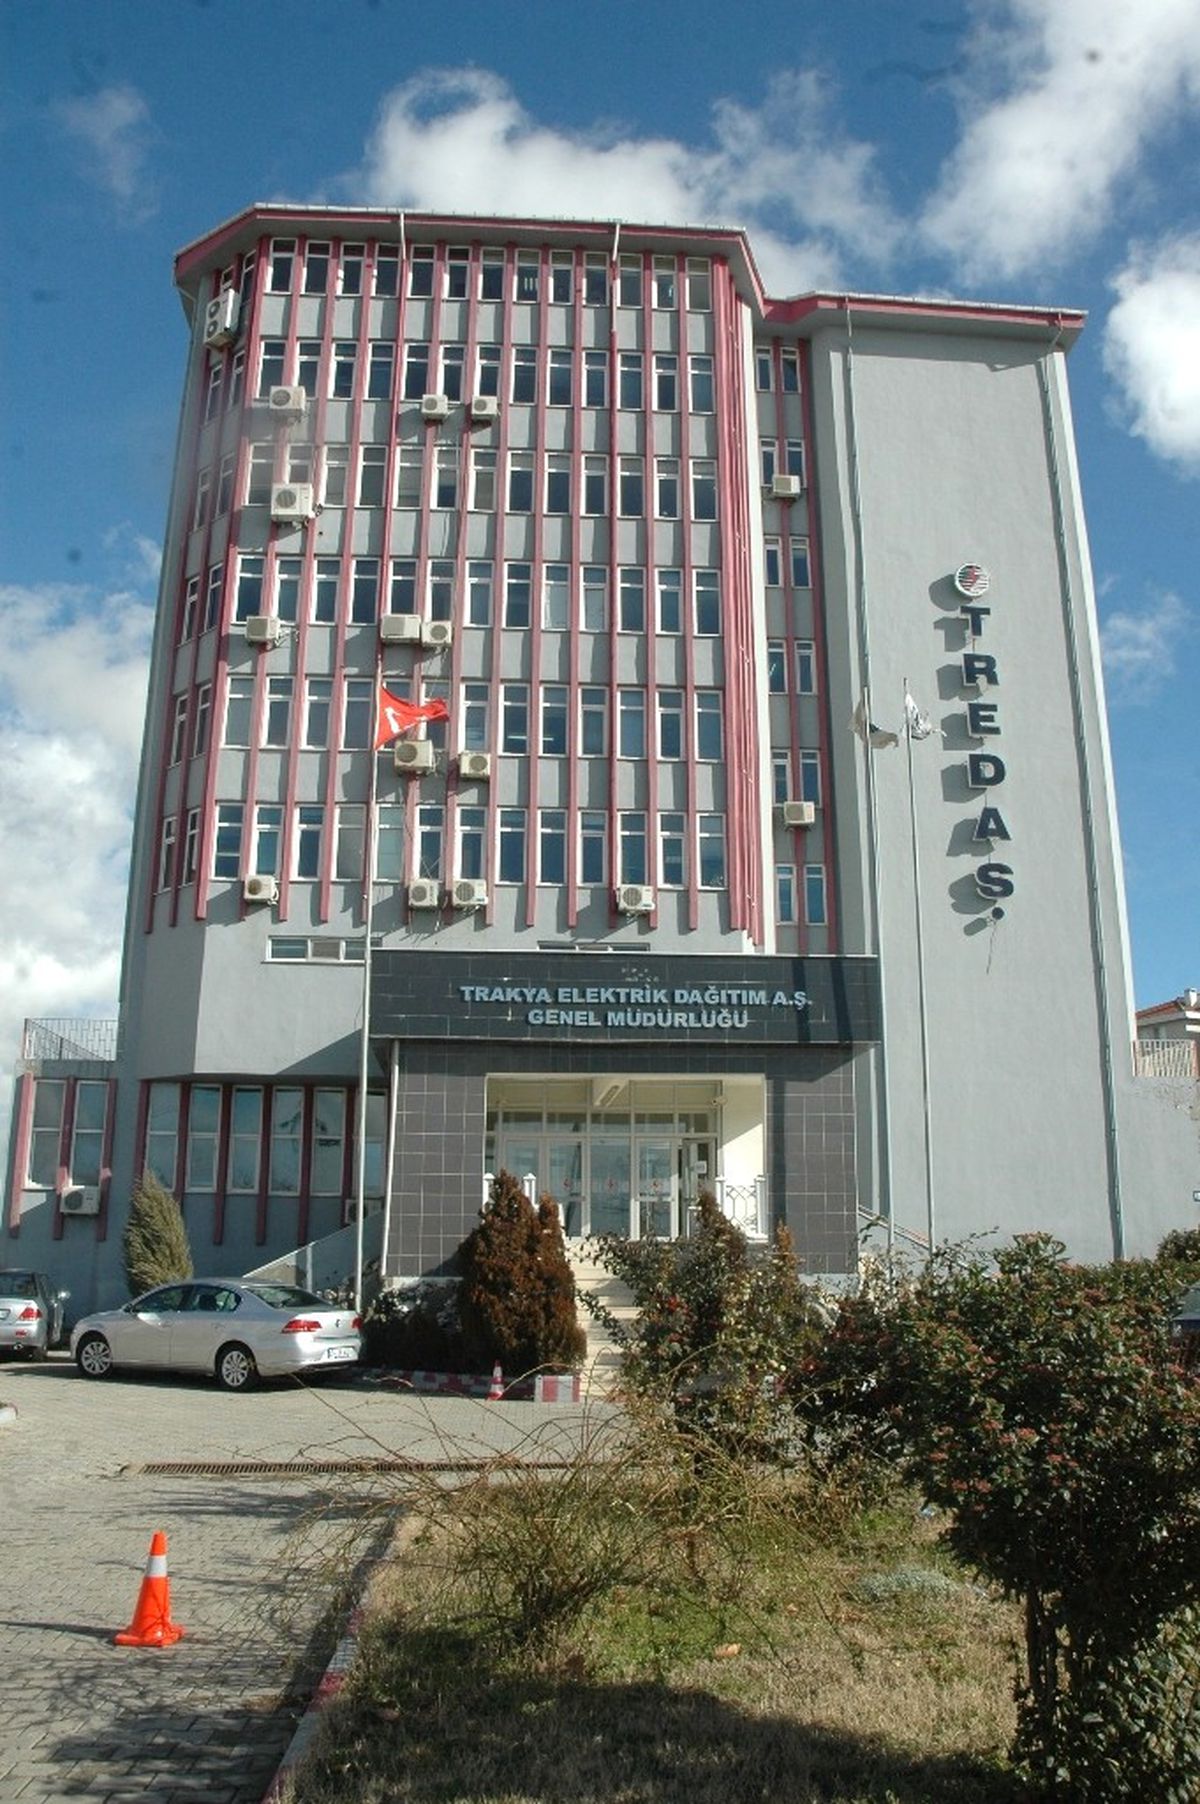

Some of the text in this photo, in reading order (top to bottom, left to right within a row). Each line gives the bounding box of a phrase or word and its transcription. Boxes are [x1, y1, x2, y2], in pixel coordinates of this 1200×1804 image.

[460, 983, 813, 1010] TRAKYA ELEKTRİK DAĞITIM A.Ş.
[528, 1008, 748, 1028] GENEL MÜDÜRLÜĞÜ
